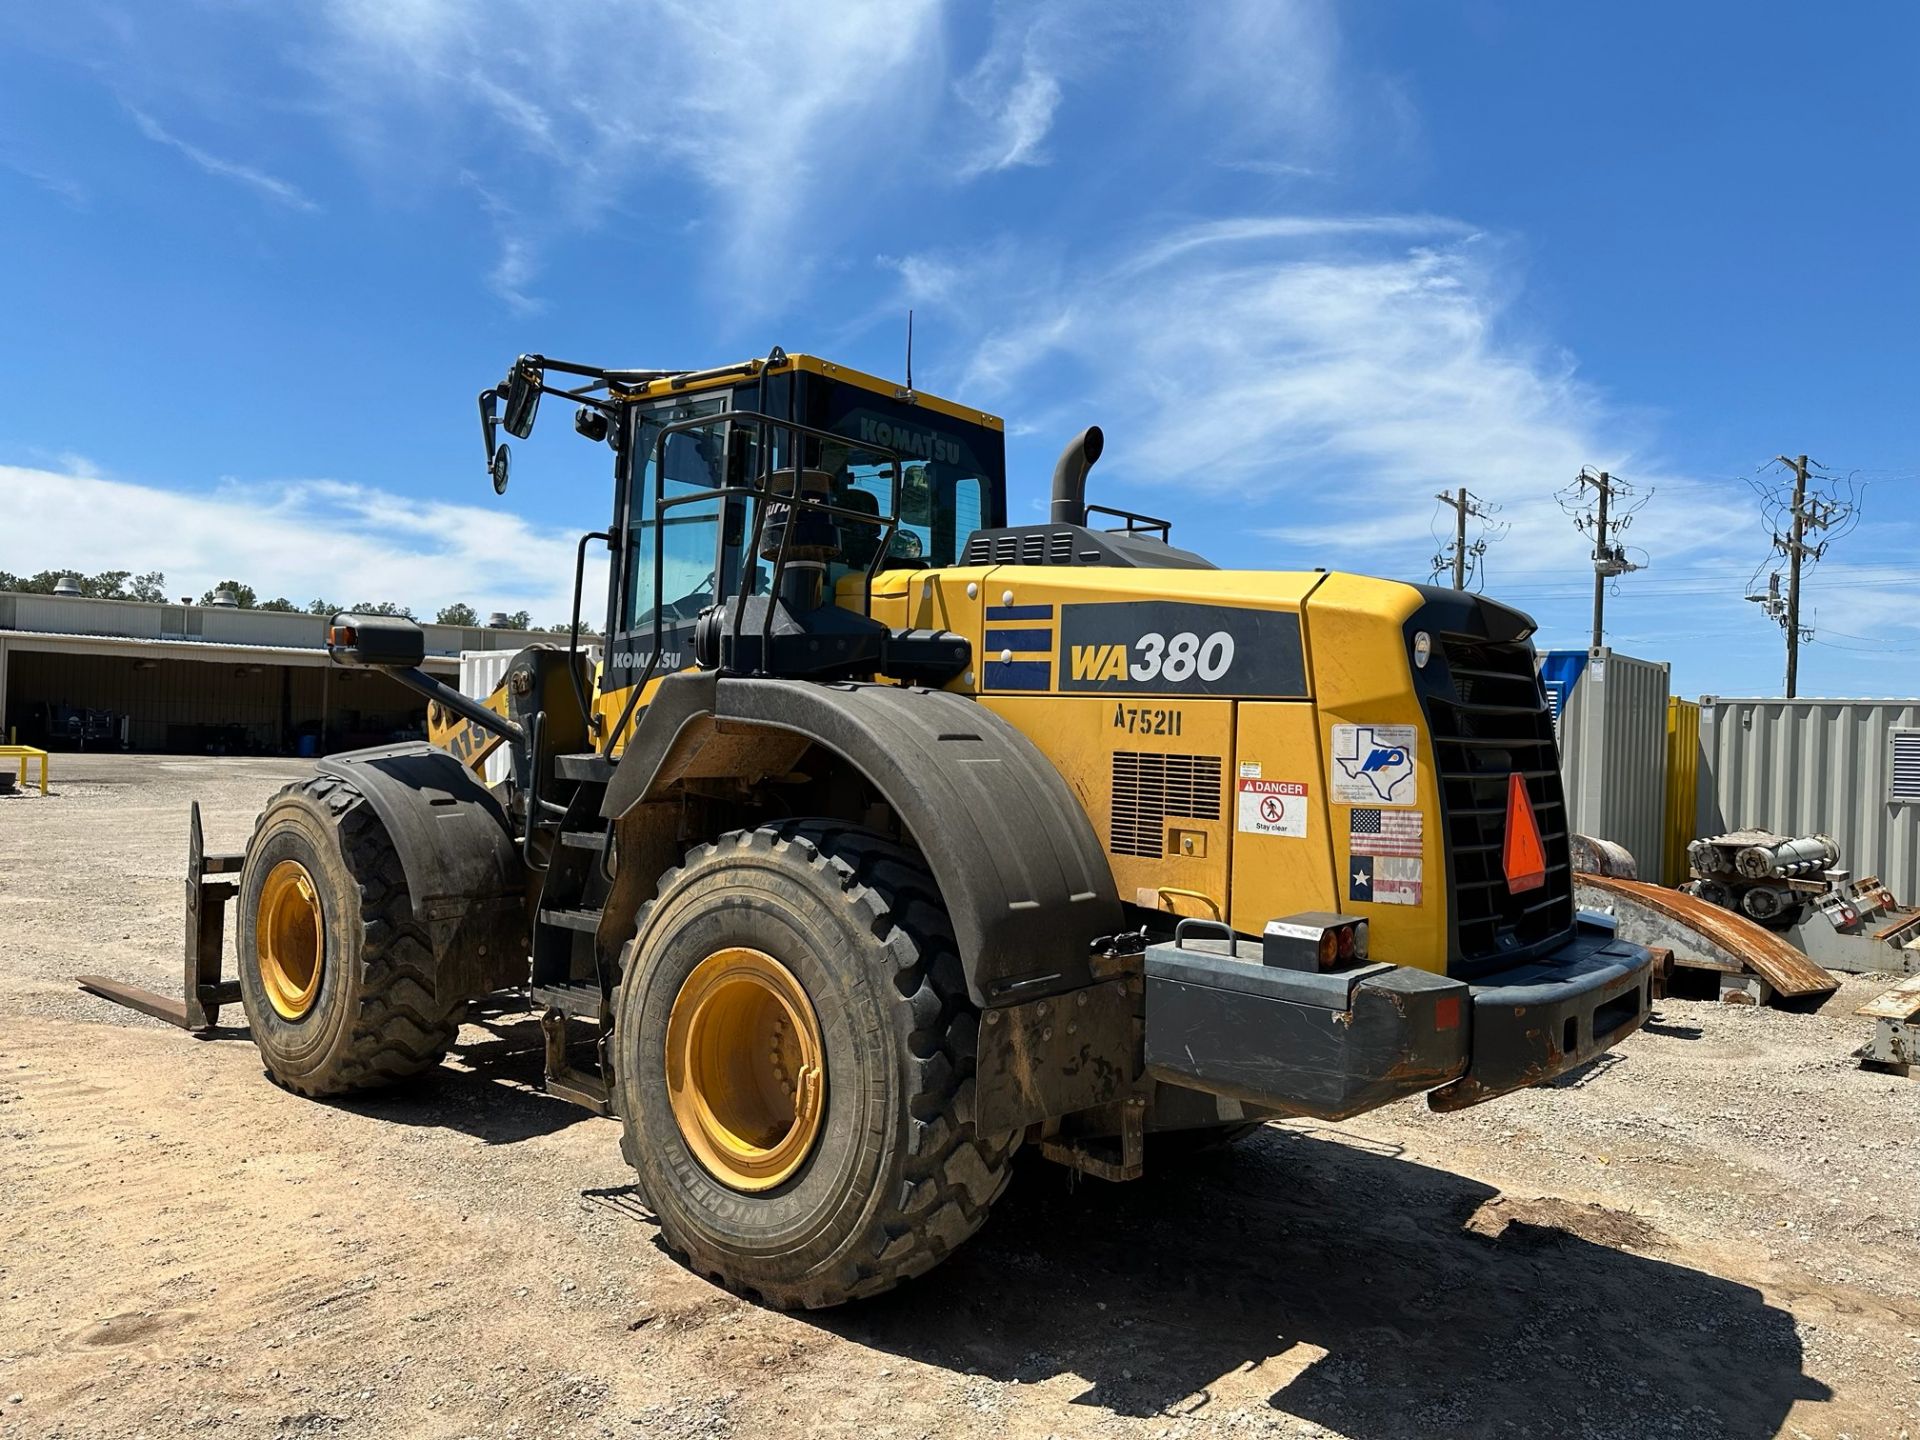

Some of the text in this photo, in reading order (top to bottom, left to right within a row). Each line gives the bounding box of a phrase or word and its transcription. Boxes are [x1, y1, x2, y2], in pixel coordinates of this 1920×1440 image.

[860, 416, 960, 465] KOMATSU
[1071, 631, 1235, 682] WA380
[1113, 702, 1182, 736] A75211
[1255, 781, 1303, 795] DANGER
[1256, 822, 1288, 832] Stay clear
[663, 1136, 769, 1225] MICHELIN
